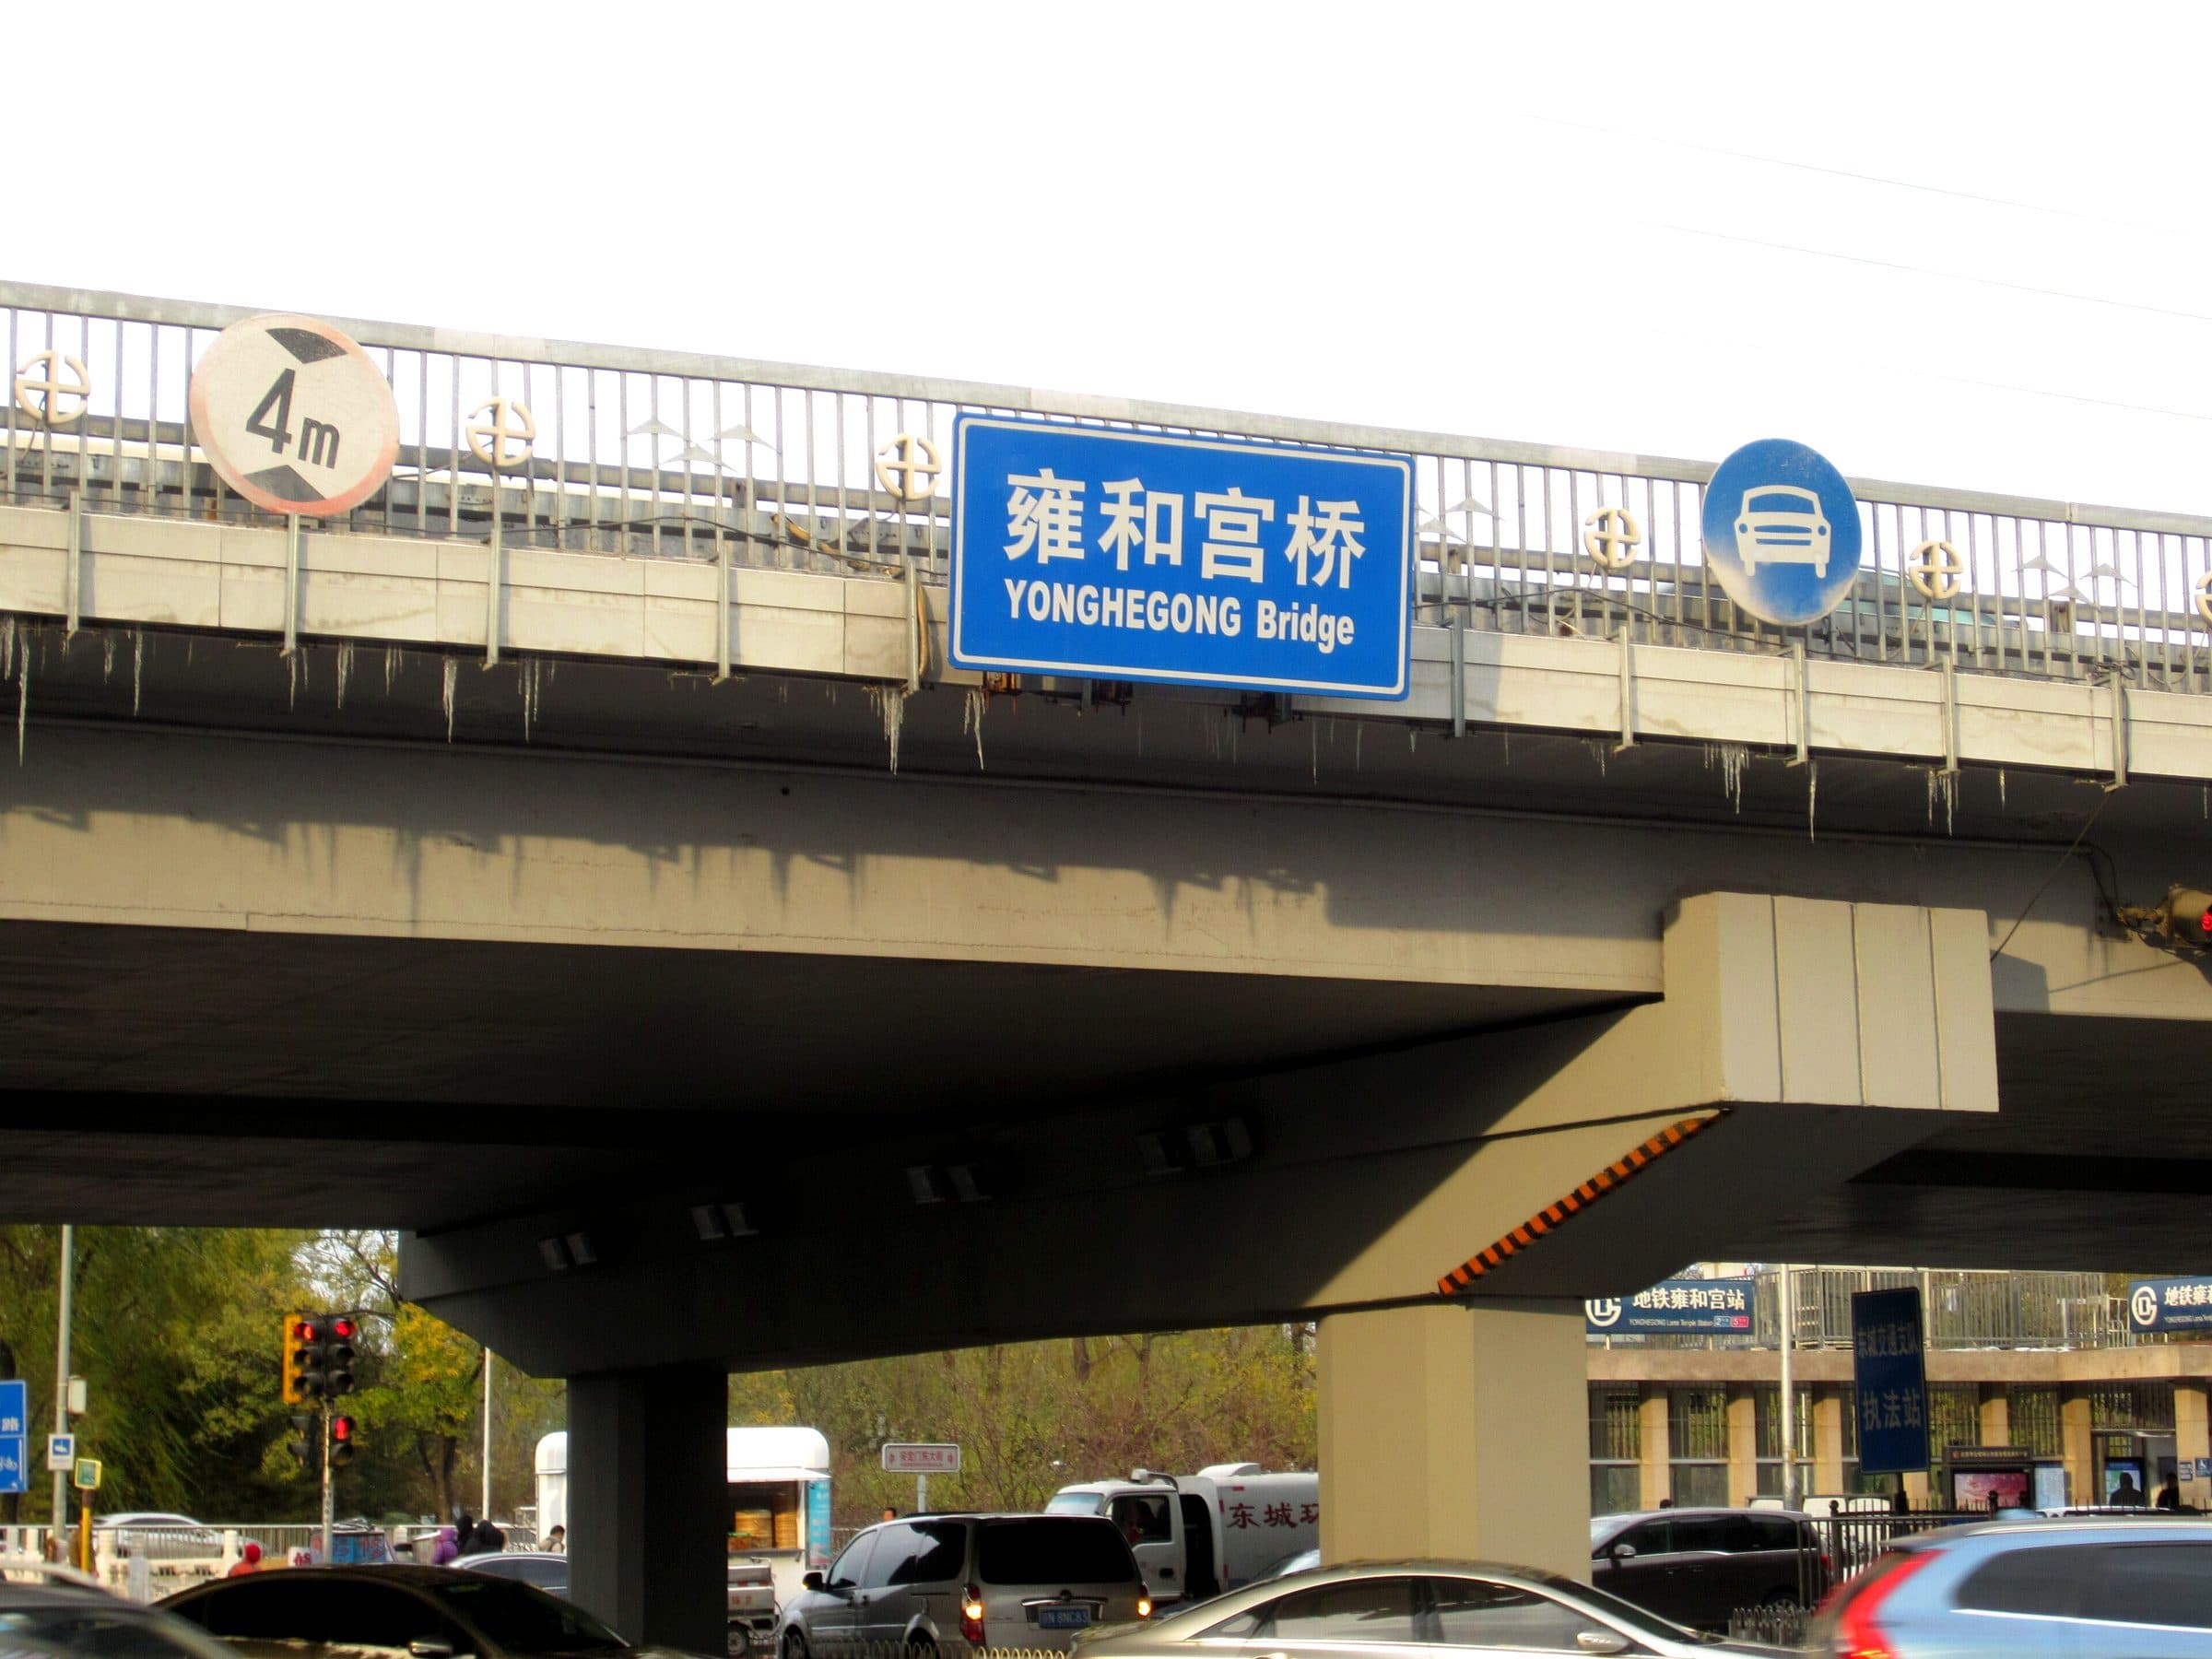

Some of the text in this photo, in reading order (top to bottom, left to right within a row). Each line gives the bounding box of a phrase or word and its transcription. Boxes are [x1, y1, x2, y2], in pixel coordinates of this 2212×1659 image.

[1003, 467, 1366, 589] 雍和宫桥
[1004, 578, 1355, 654] YONGHEGONG Bridge
[1632, 1288, 1746, 1311] 地铁雍和宫站
[1862, 1386, 1921, 1431] 执法站
